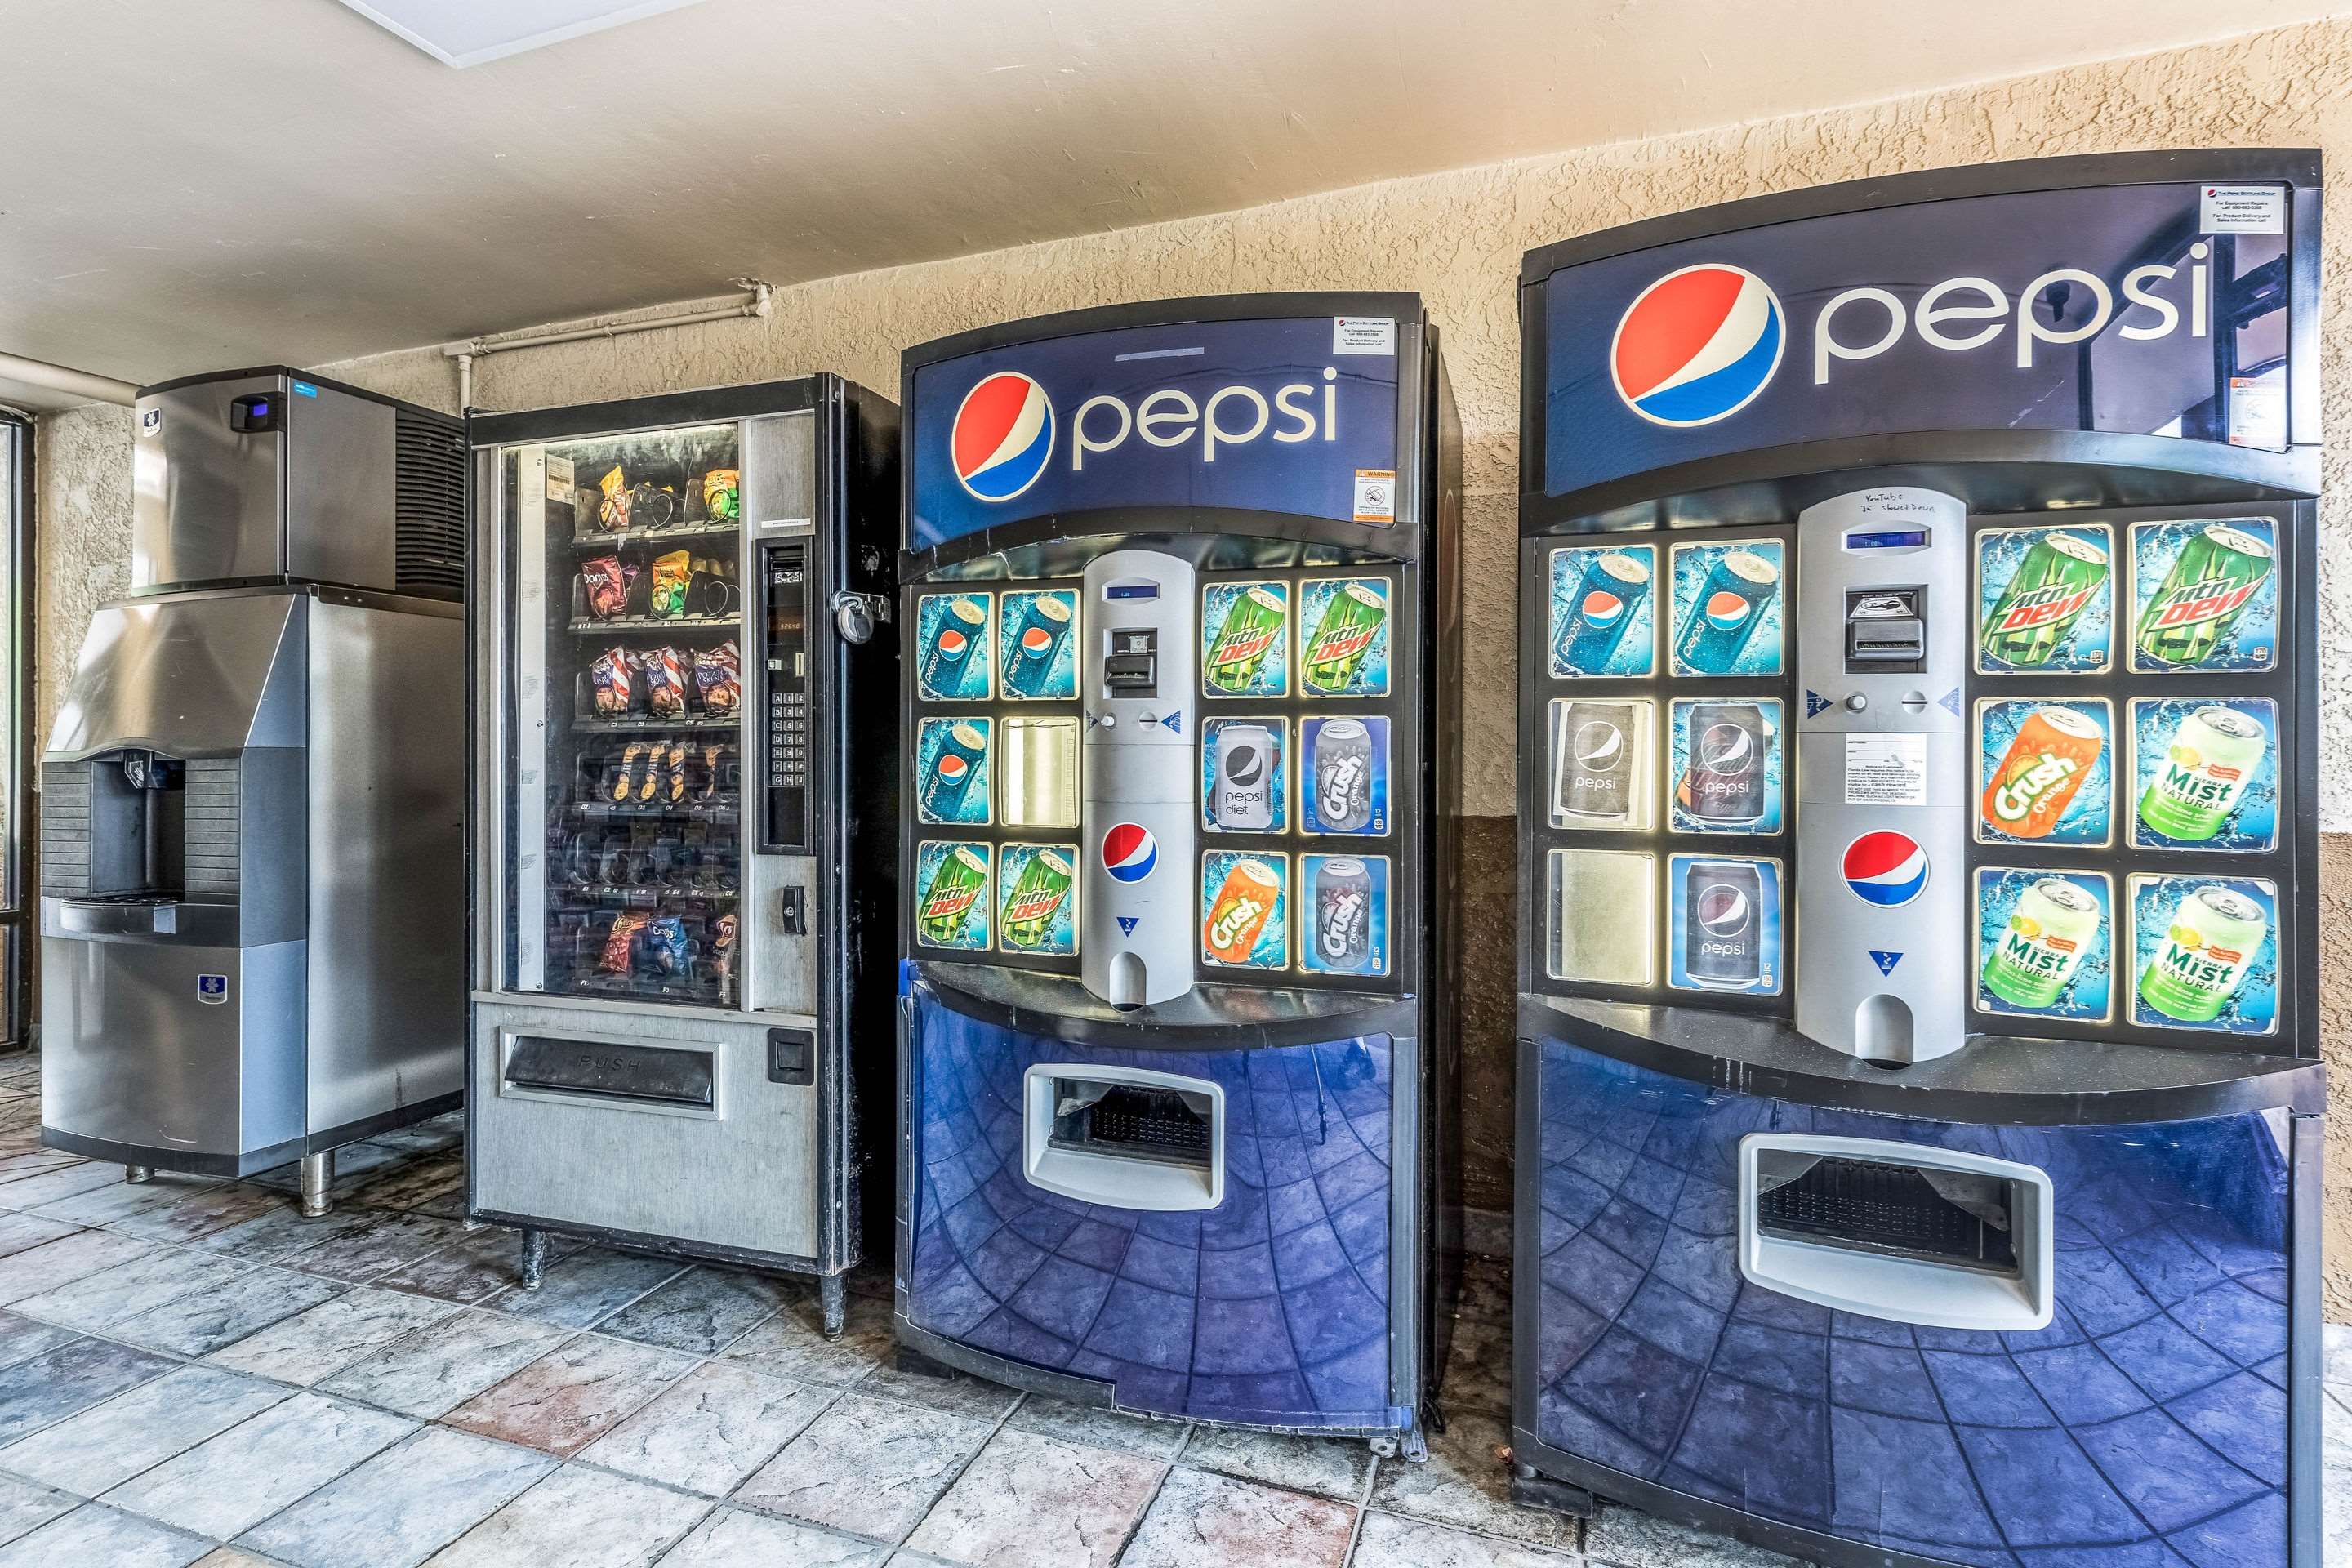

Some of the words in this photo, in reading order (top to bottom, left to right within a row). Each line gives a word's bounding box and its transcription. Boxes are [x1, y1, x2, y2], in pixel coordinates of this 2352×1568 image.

[1815, 241, 2209, 385] pepsi
[1073, 366, 1337, 470] pepsi
[1225, 790, 1263, 804] pepsi
[1575, 776, 1616, 791] pepsi
[1704, 780, 1749, 795] pepsi
[1994, 753, 2078, 821] Crush
[2161, 782, 2222, 811] NATURAL
[2165, 764, 2234, 802] Mist
[1225, 804, 1249, 815] diet
[1210, 895, 1263, 950] Crush
[1701, 942, 1745, 958] pepsi
[2007, 933, 2069, 973] Mist
[2165, 943, 2234, 984] Mist
[2002, 951, 2059, 981] NATURAL
[2161, 962, 2222, 993] NATURAL
[578, 1054, 641, 1072] PUSH
